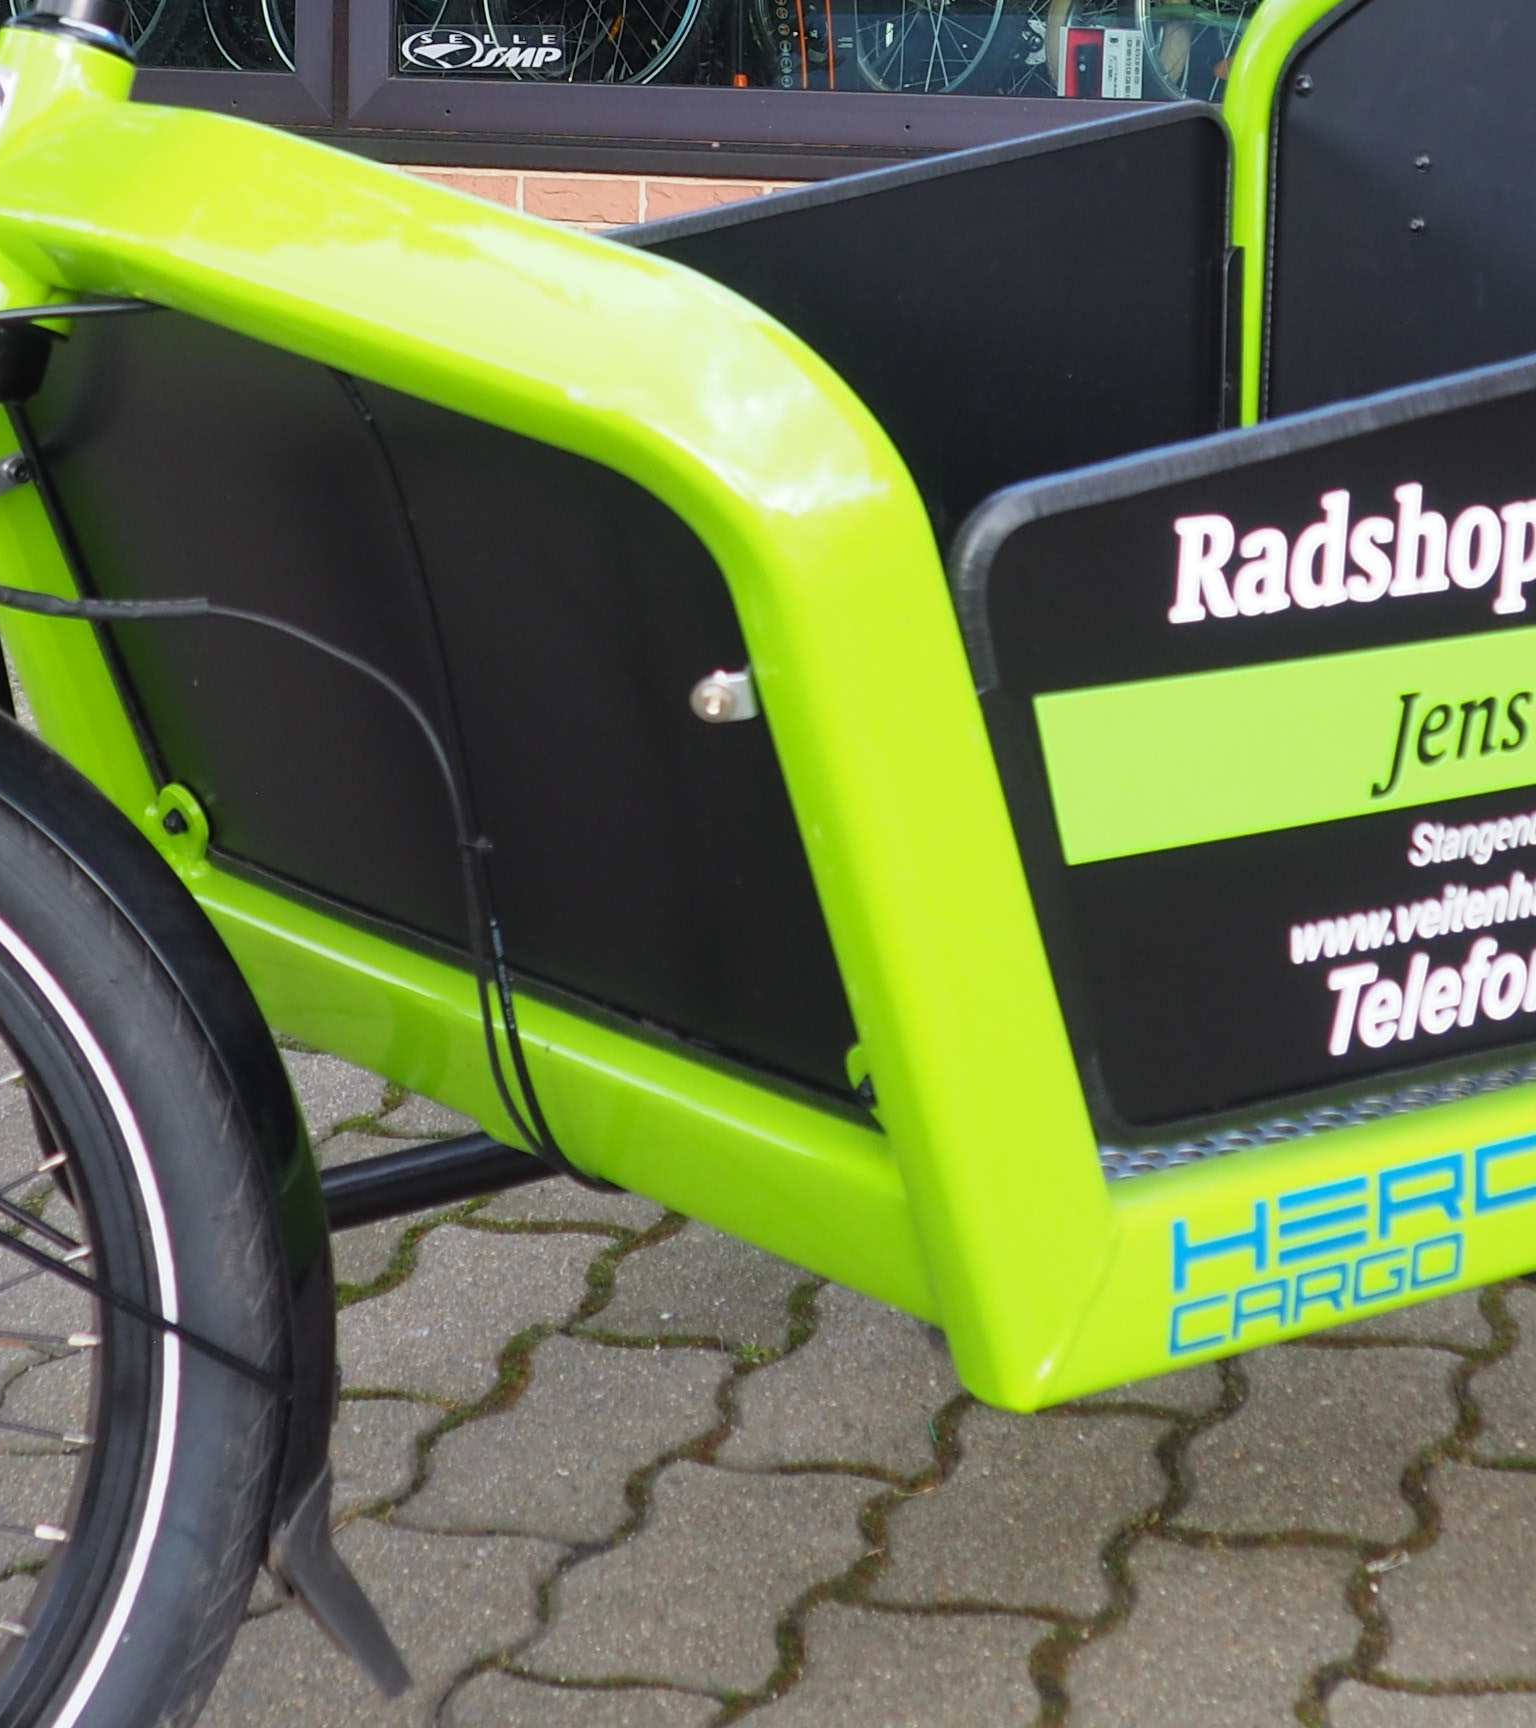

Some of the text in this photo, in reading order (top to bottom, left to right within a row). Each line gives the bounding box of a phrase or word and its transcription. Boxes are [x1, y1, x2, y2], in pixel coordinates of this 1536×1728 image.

[420, 34, 557, 45] SELLE
[471, 46, 563, 68] SMP
[1370, 691, 1533, 798] Jens
[1168, 1231, 1465, 1357] CARGO
